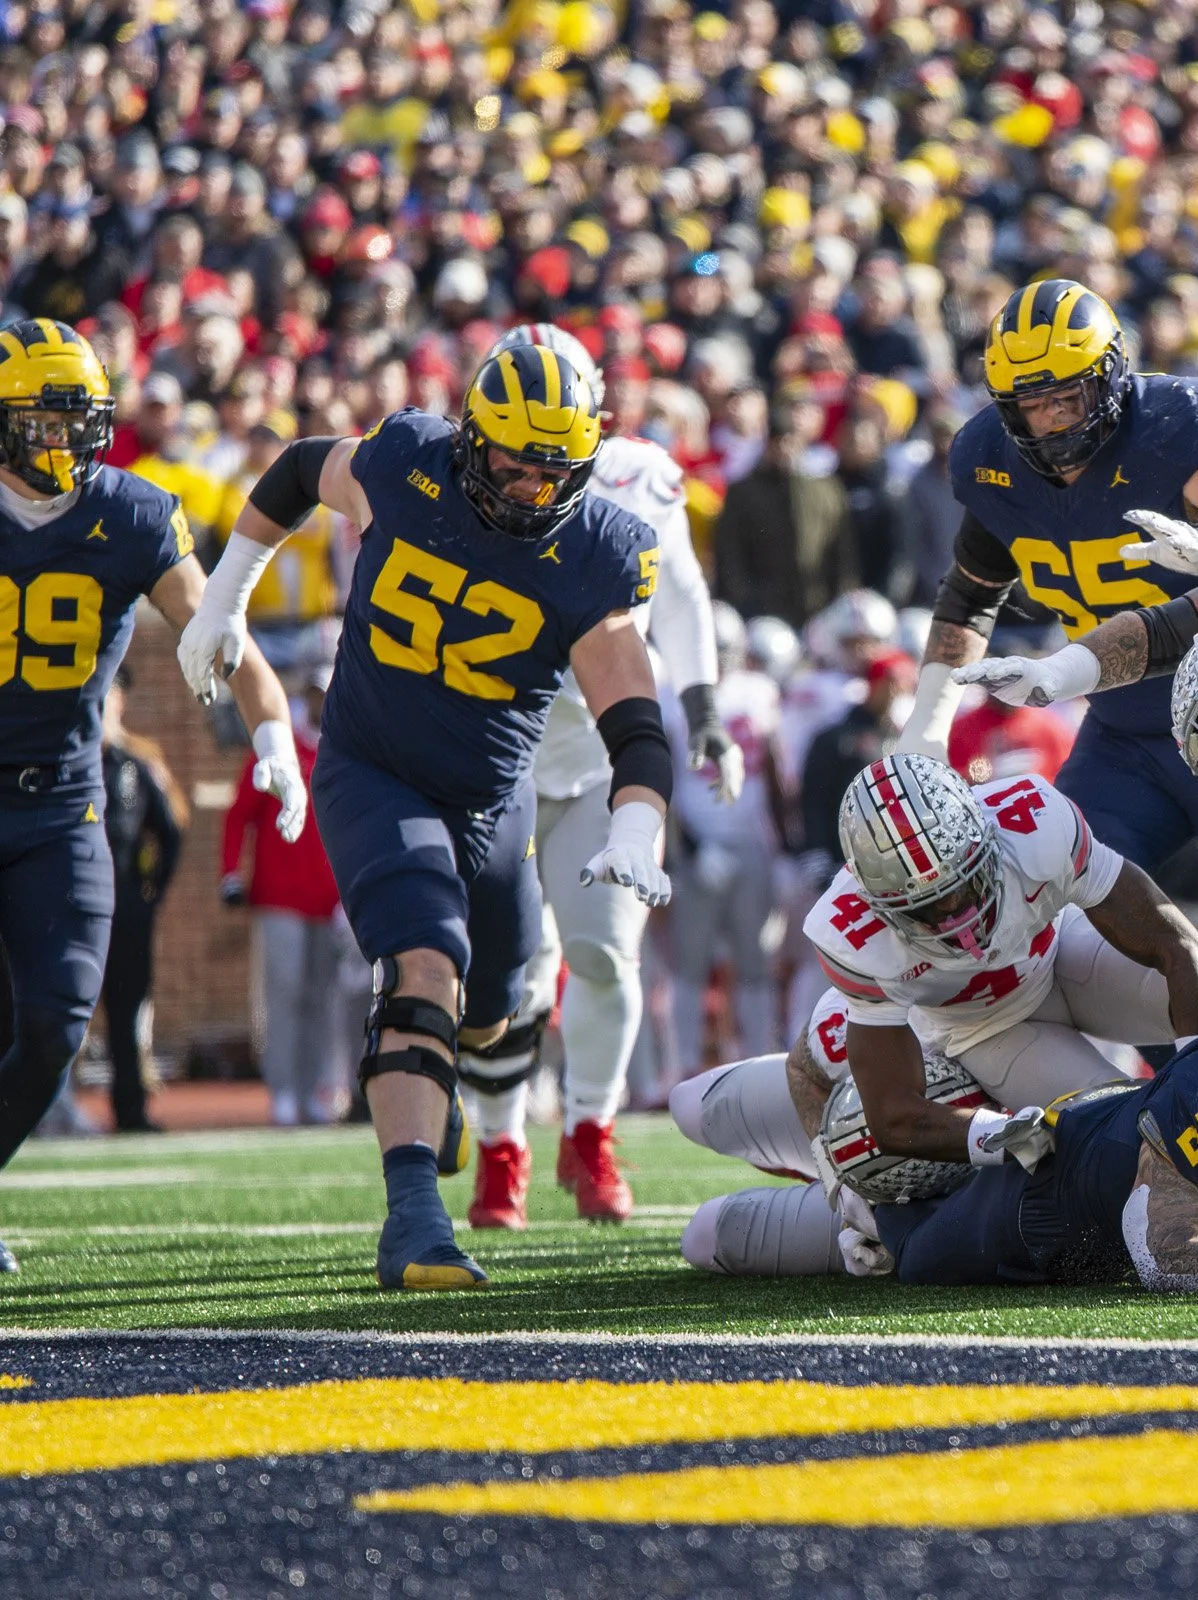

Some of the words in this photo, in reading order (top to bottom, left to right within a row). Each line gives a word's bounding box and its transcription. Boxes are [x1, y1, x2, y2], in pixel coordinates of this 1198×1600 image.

[0, 572, 104, 691] 9
[369, 537, 545, 701] 52
[1010, 532, 1172, 641] 65
[983, 779, 1046, 834] 41
[829, 893, 888, 951] 41
